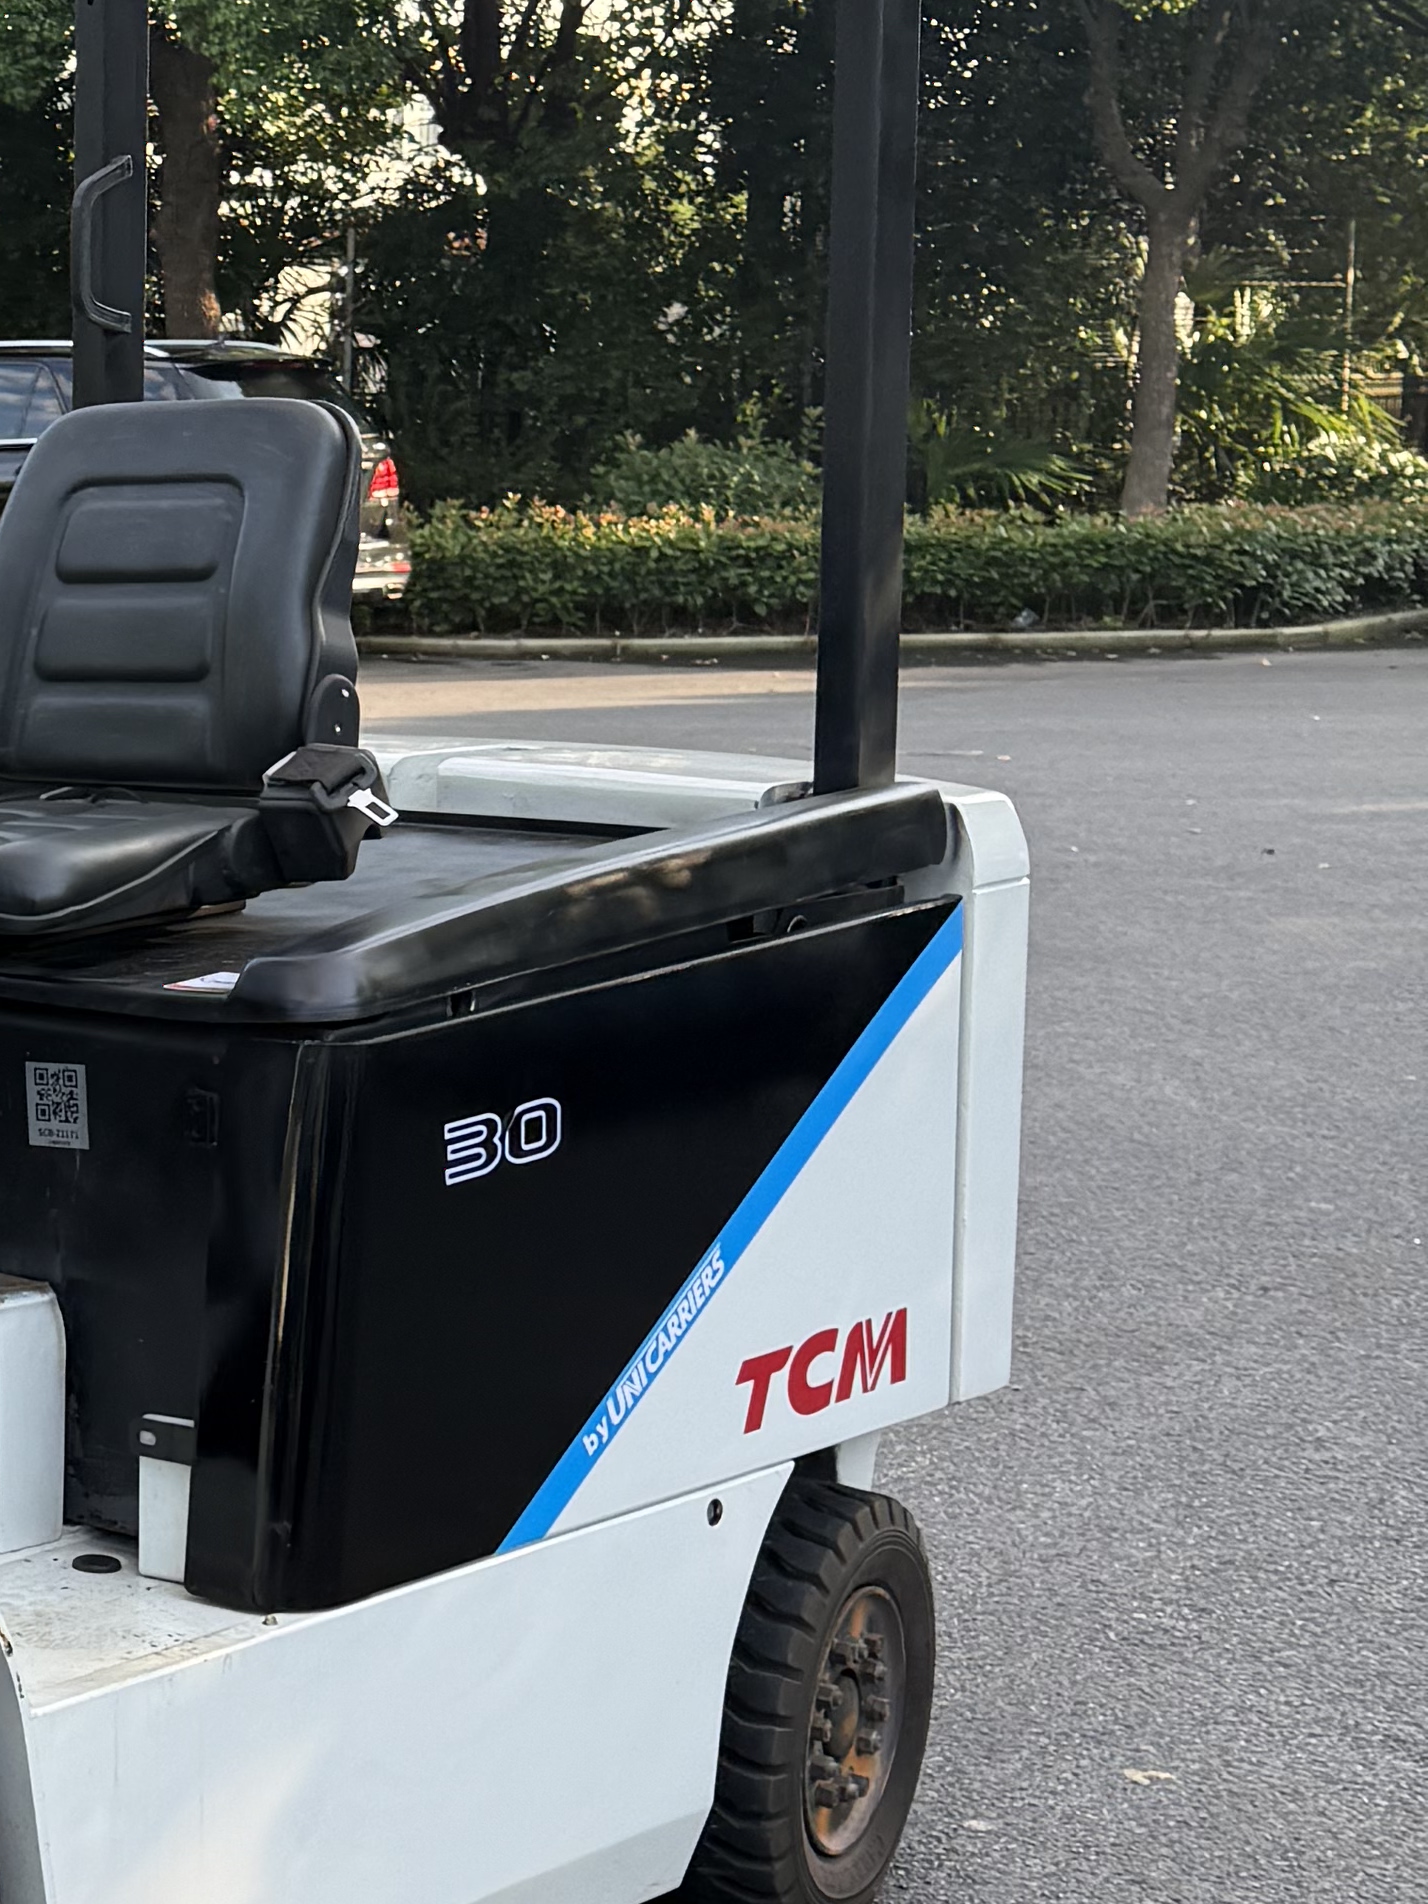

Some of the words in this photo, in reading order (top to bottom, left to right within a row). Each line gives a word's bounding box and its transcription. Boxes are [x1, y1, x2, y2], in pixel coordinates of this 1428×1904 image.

[444, 1097, 562, 1186] 30
[582, 1415, 608, 1456] by
[605, 1245, 725, 1425] UNICARRIERS
[735, 1307, 907, 1434] TCM
